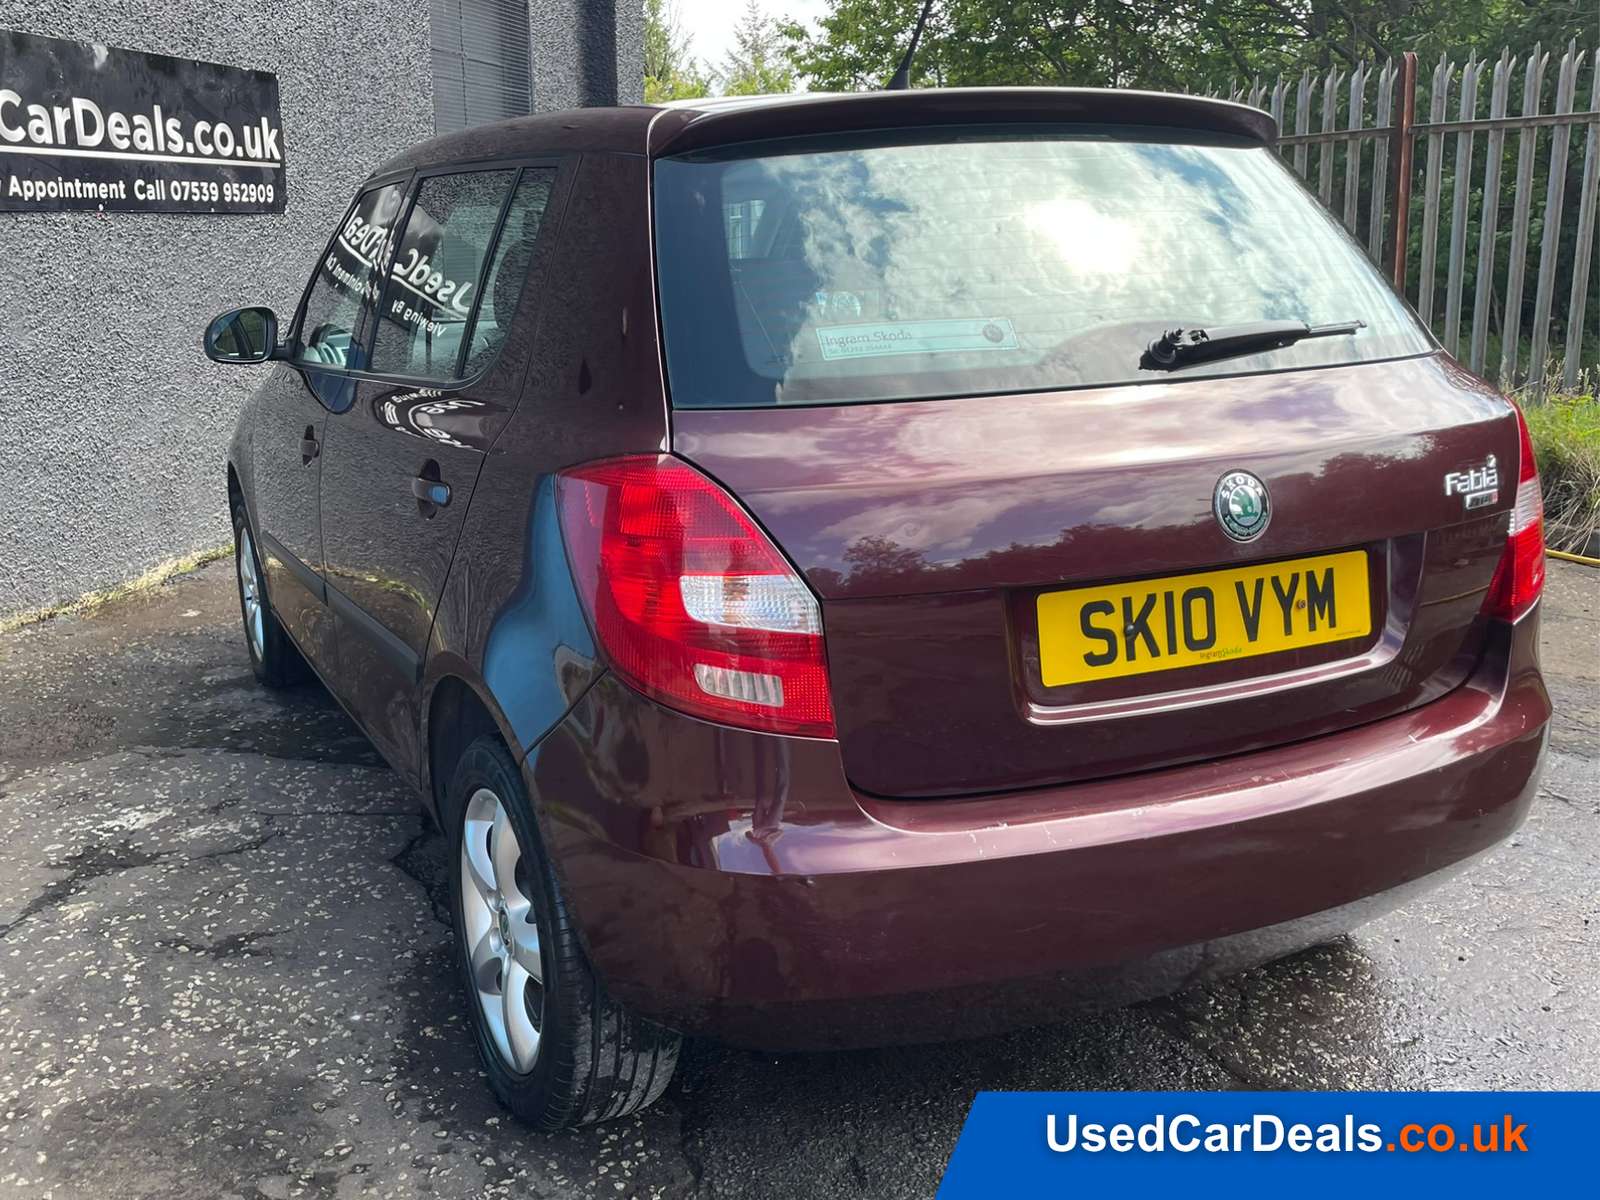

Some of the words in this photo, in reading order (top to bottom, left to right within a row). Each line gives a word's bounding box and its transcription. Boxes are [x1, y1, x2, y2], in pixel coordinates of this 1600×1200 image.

[8, 175, 126, 201] Appointment
[134, 179, 166, 201] Call
[170, 180, 219, 201] 07539
[223, 183, 274, 203] 952909
[823, 335, 870, 347] Ingram
[871, 329, 913, 342] Skoda
[1444, 466, 1498, 496] Fabia
[1079, 586, 1217, 667] SK10
[1234, 567, 1337, 643] VYM
